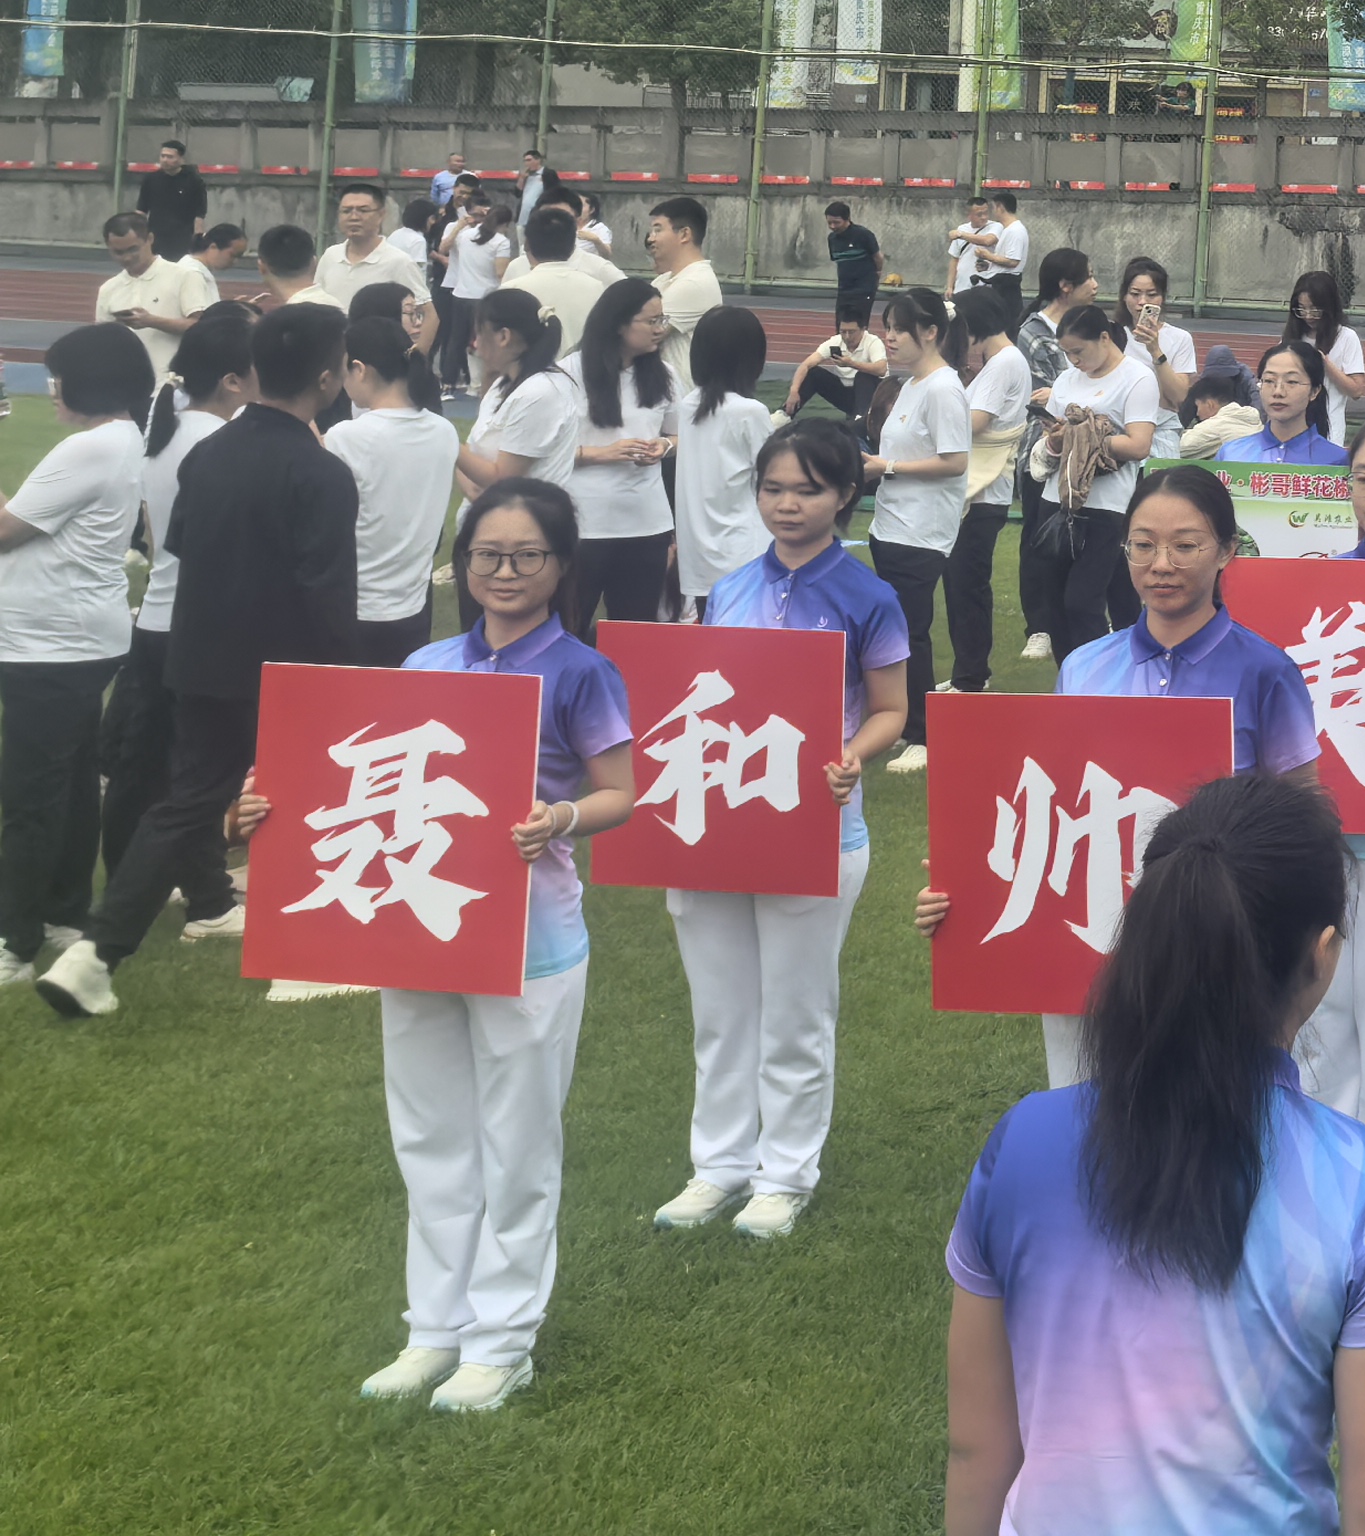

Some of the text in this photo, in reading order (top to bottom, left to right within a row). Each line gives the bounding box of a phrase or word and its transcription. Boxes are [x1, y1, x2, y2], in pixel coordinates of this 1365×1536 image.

[280, 718, 490, 942] 聂
[633, 669, 806, 846] 和
[980, 756, 1180, 956] 帅
